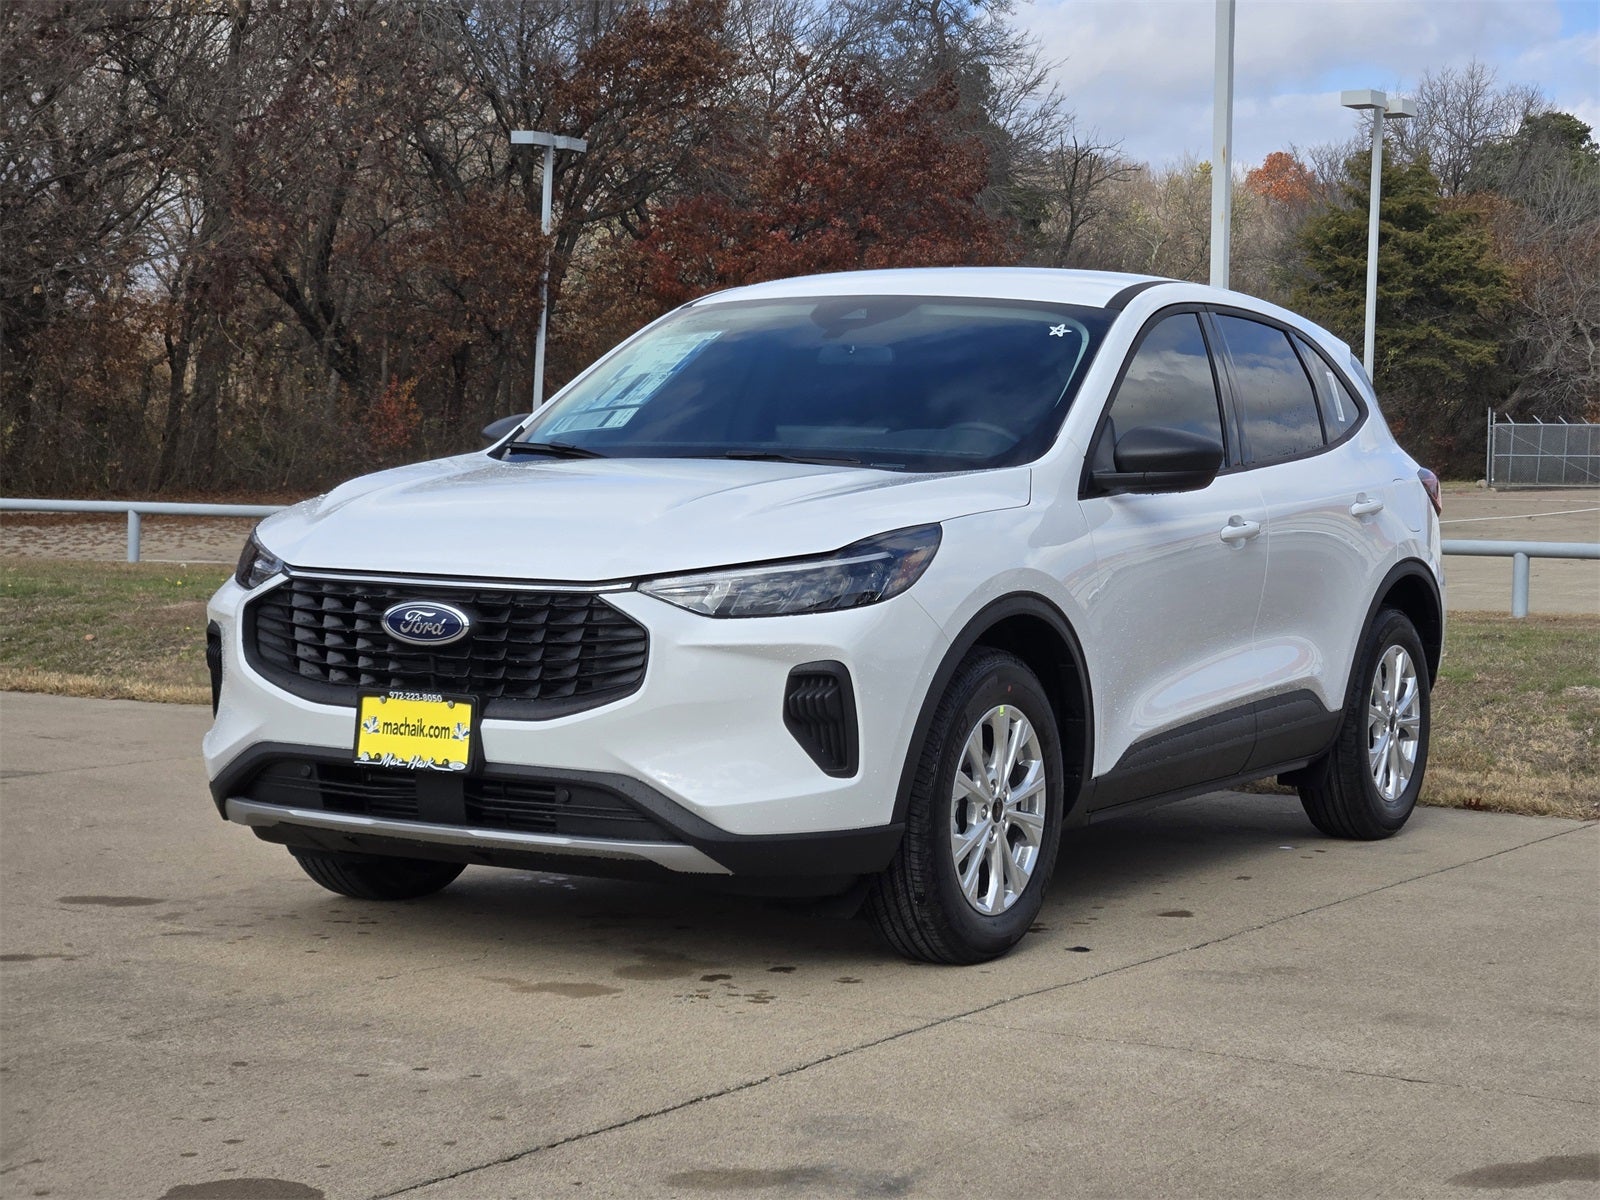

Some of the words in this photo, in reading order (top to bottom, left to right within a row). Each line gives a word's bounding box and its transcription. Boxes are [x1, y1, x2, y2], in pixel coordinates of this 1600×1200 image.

[400, 610, 447, 635] Ford
[388, 691, 442, 703] 972-223-8050
[382, 717, 451, 739] machaik.com
[379, 753, 406, 766] Mac
